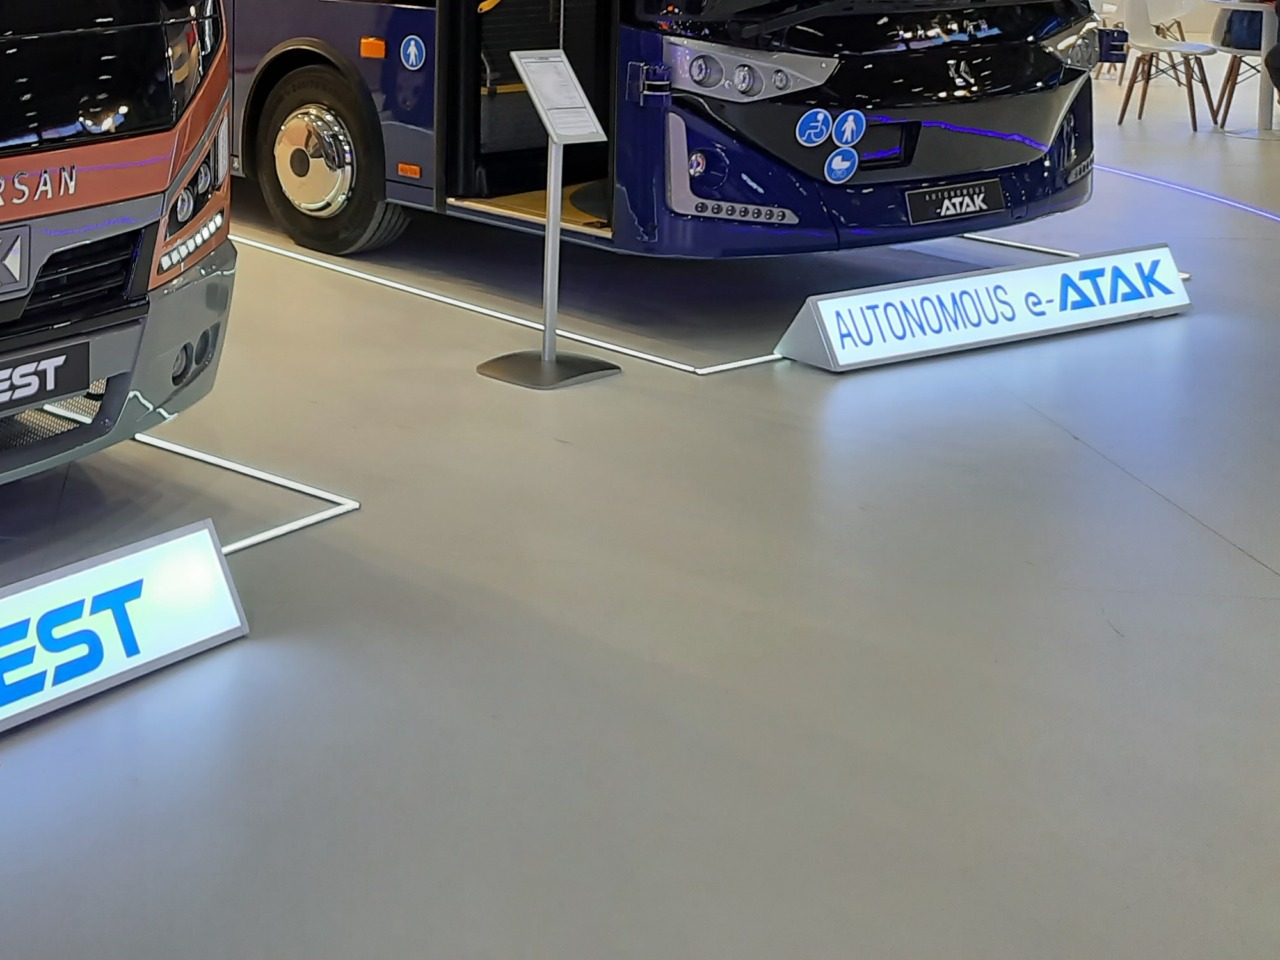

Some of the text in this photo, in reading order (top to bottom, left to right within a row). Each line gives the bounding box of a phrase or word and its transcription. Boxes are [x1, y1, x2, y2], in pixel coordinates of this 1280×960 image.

[925, 185, 986, 201] AUTONOMOUS
[834, 258, 1176, 351] AUTONOMOUS e-ATAK
